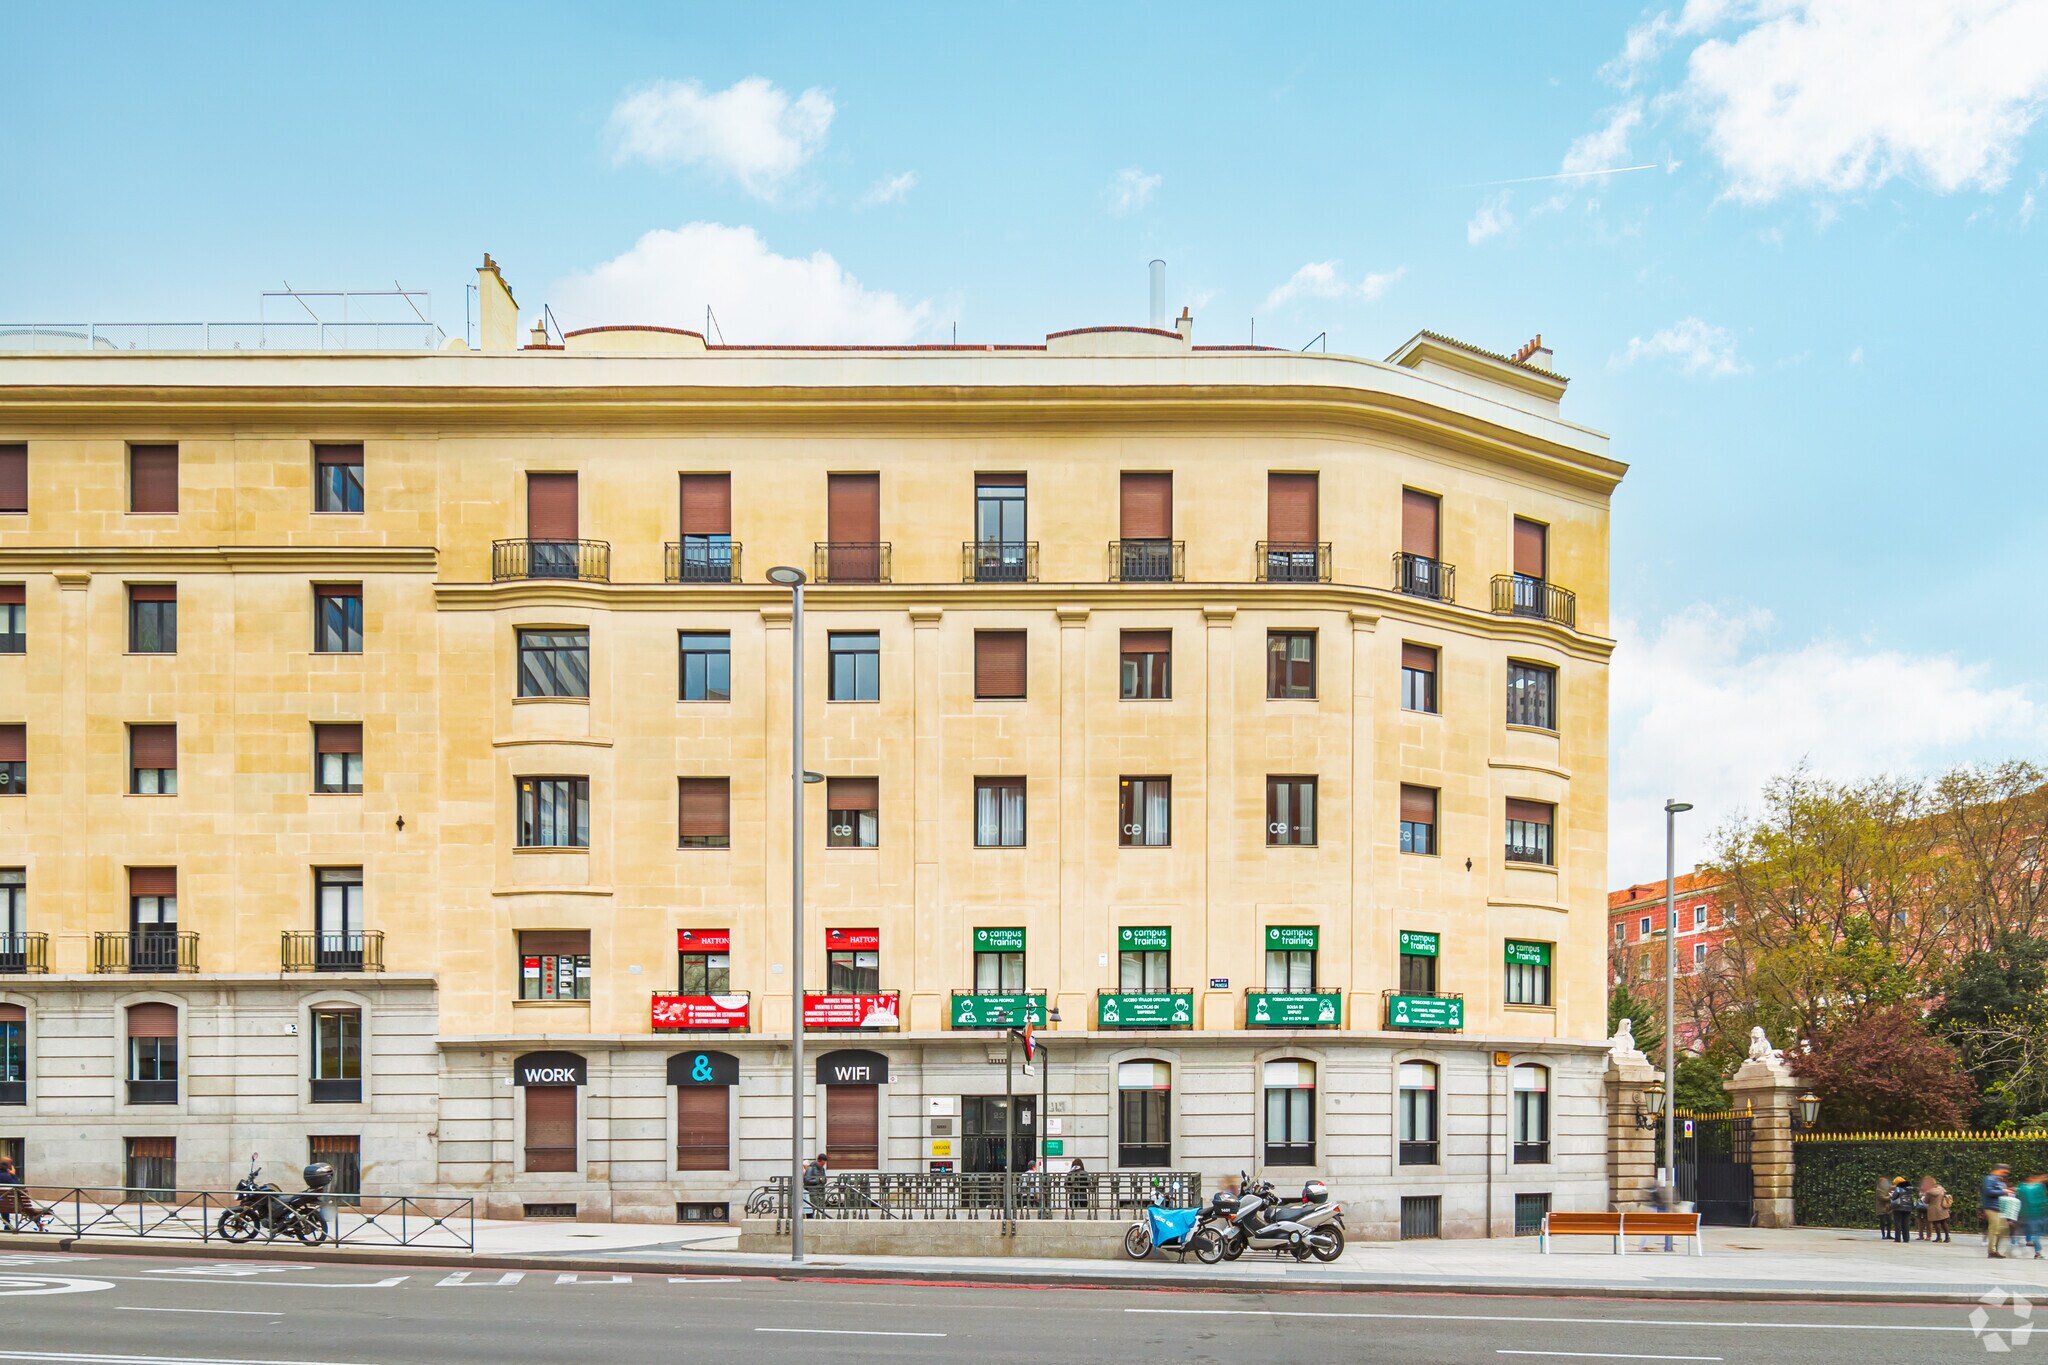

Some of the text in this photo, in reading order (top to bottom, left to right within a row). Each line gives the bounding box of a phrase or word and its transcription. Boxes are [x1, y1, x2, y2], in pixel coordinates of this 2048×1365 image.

[834, 824, 852, 836] ce
[1124, 824, 1142, 836] ce
[1270, 822, 1287, 834] ce
[990, 930, 1022, 939] campus
[1134, 930, 1166, 938] campus
[1282, 929, 1313, 938] campus
[1410, 934, 1435, 943] campus
[990, 938, 1022, 948] training
[1134, 937, 1166, 947] training
[1282, 936, 1314, 947] training
[1410, 942, 1436, 953] training
[1516, 944, 1540, 954] campus
[1516, 952, 1540, 963] training
[692, 1054, 713, 1081] &
[834, 1066, 870, 1080] WIFI
[524, 1068, 575, 1082] WORK
